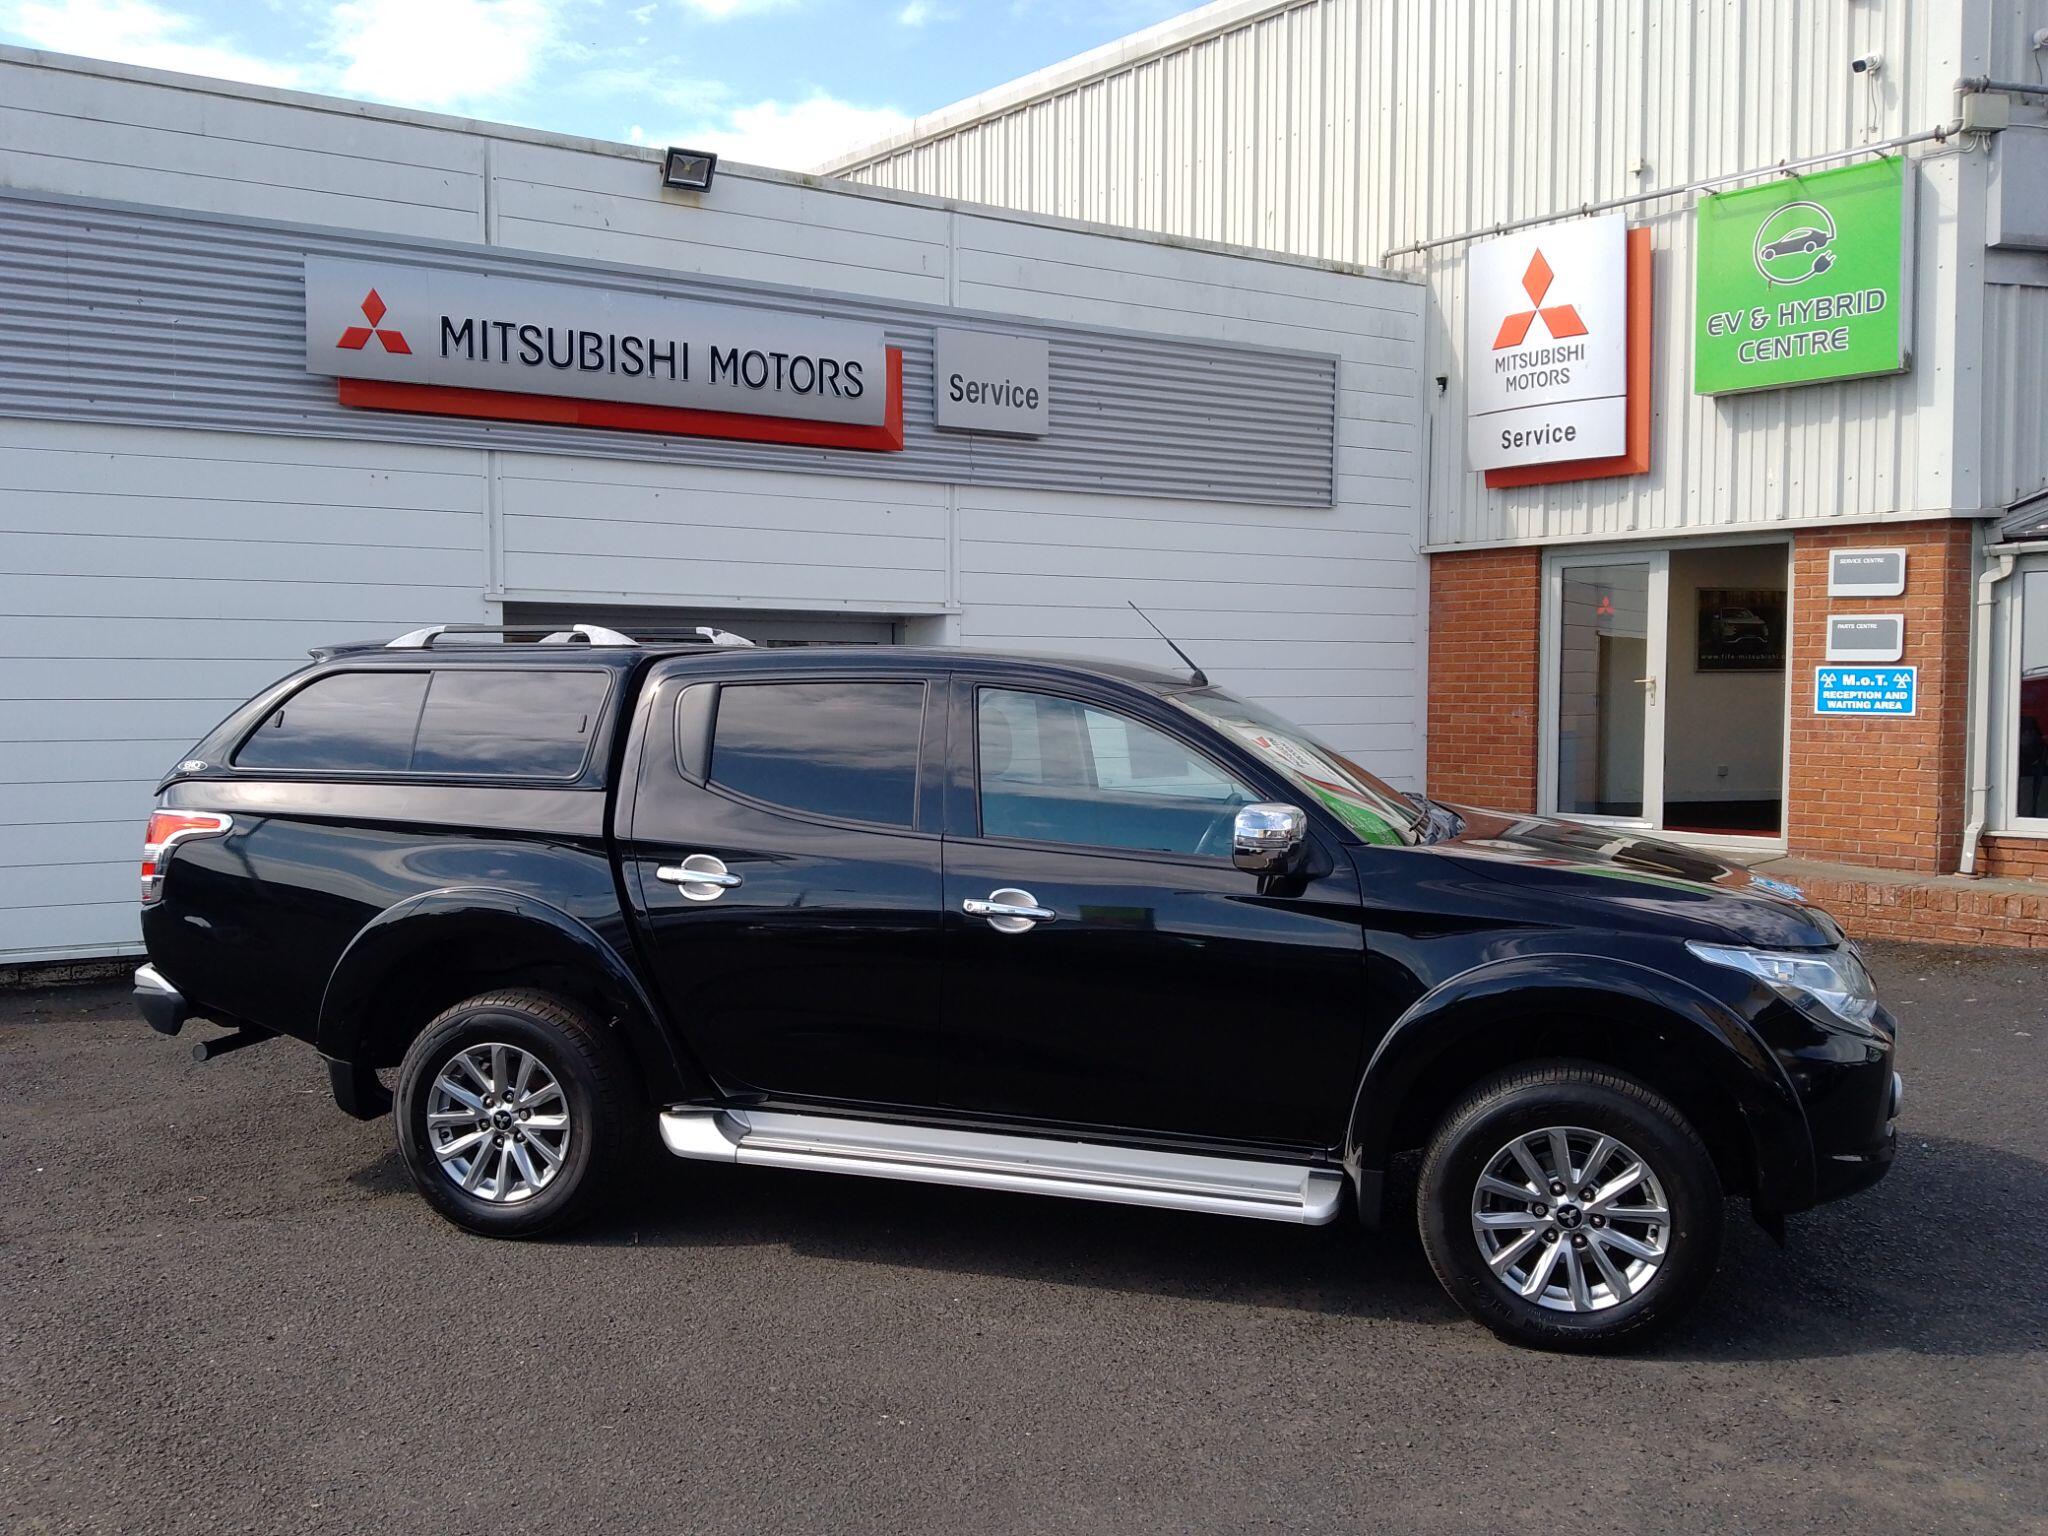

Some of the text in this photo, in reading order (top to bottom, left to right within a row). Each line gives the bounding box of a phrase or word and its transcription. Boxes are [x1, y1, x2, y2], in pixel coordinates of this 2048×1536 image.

[1707, 288, 1887, 337] EV & HYBRID
[439, 315, 864, 399] MITSUBISHI MOTORS
[1494, 343, 1585, 374] MITSUBISHI
[1738, 326, 1849, 365] CENTRE
[949, 373, 1039, 410] Service
[1505, 367, 1571, 393] MOTORS
[1501, 423, 1577, 450] Service
[1842, 674, 1889, 686] M.o.T.
[1822, 690, 1908, 700] RECEPTION AND
[1827, 700, 1903, 710] WAITING AREA
